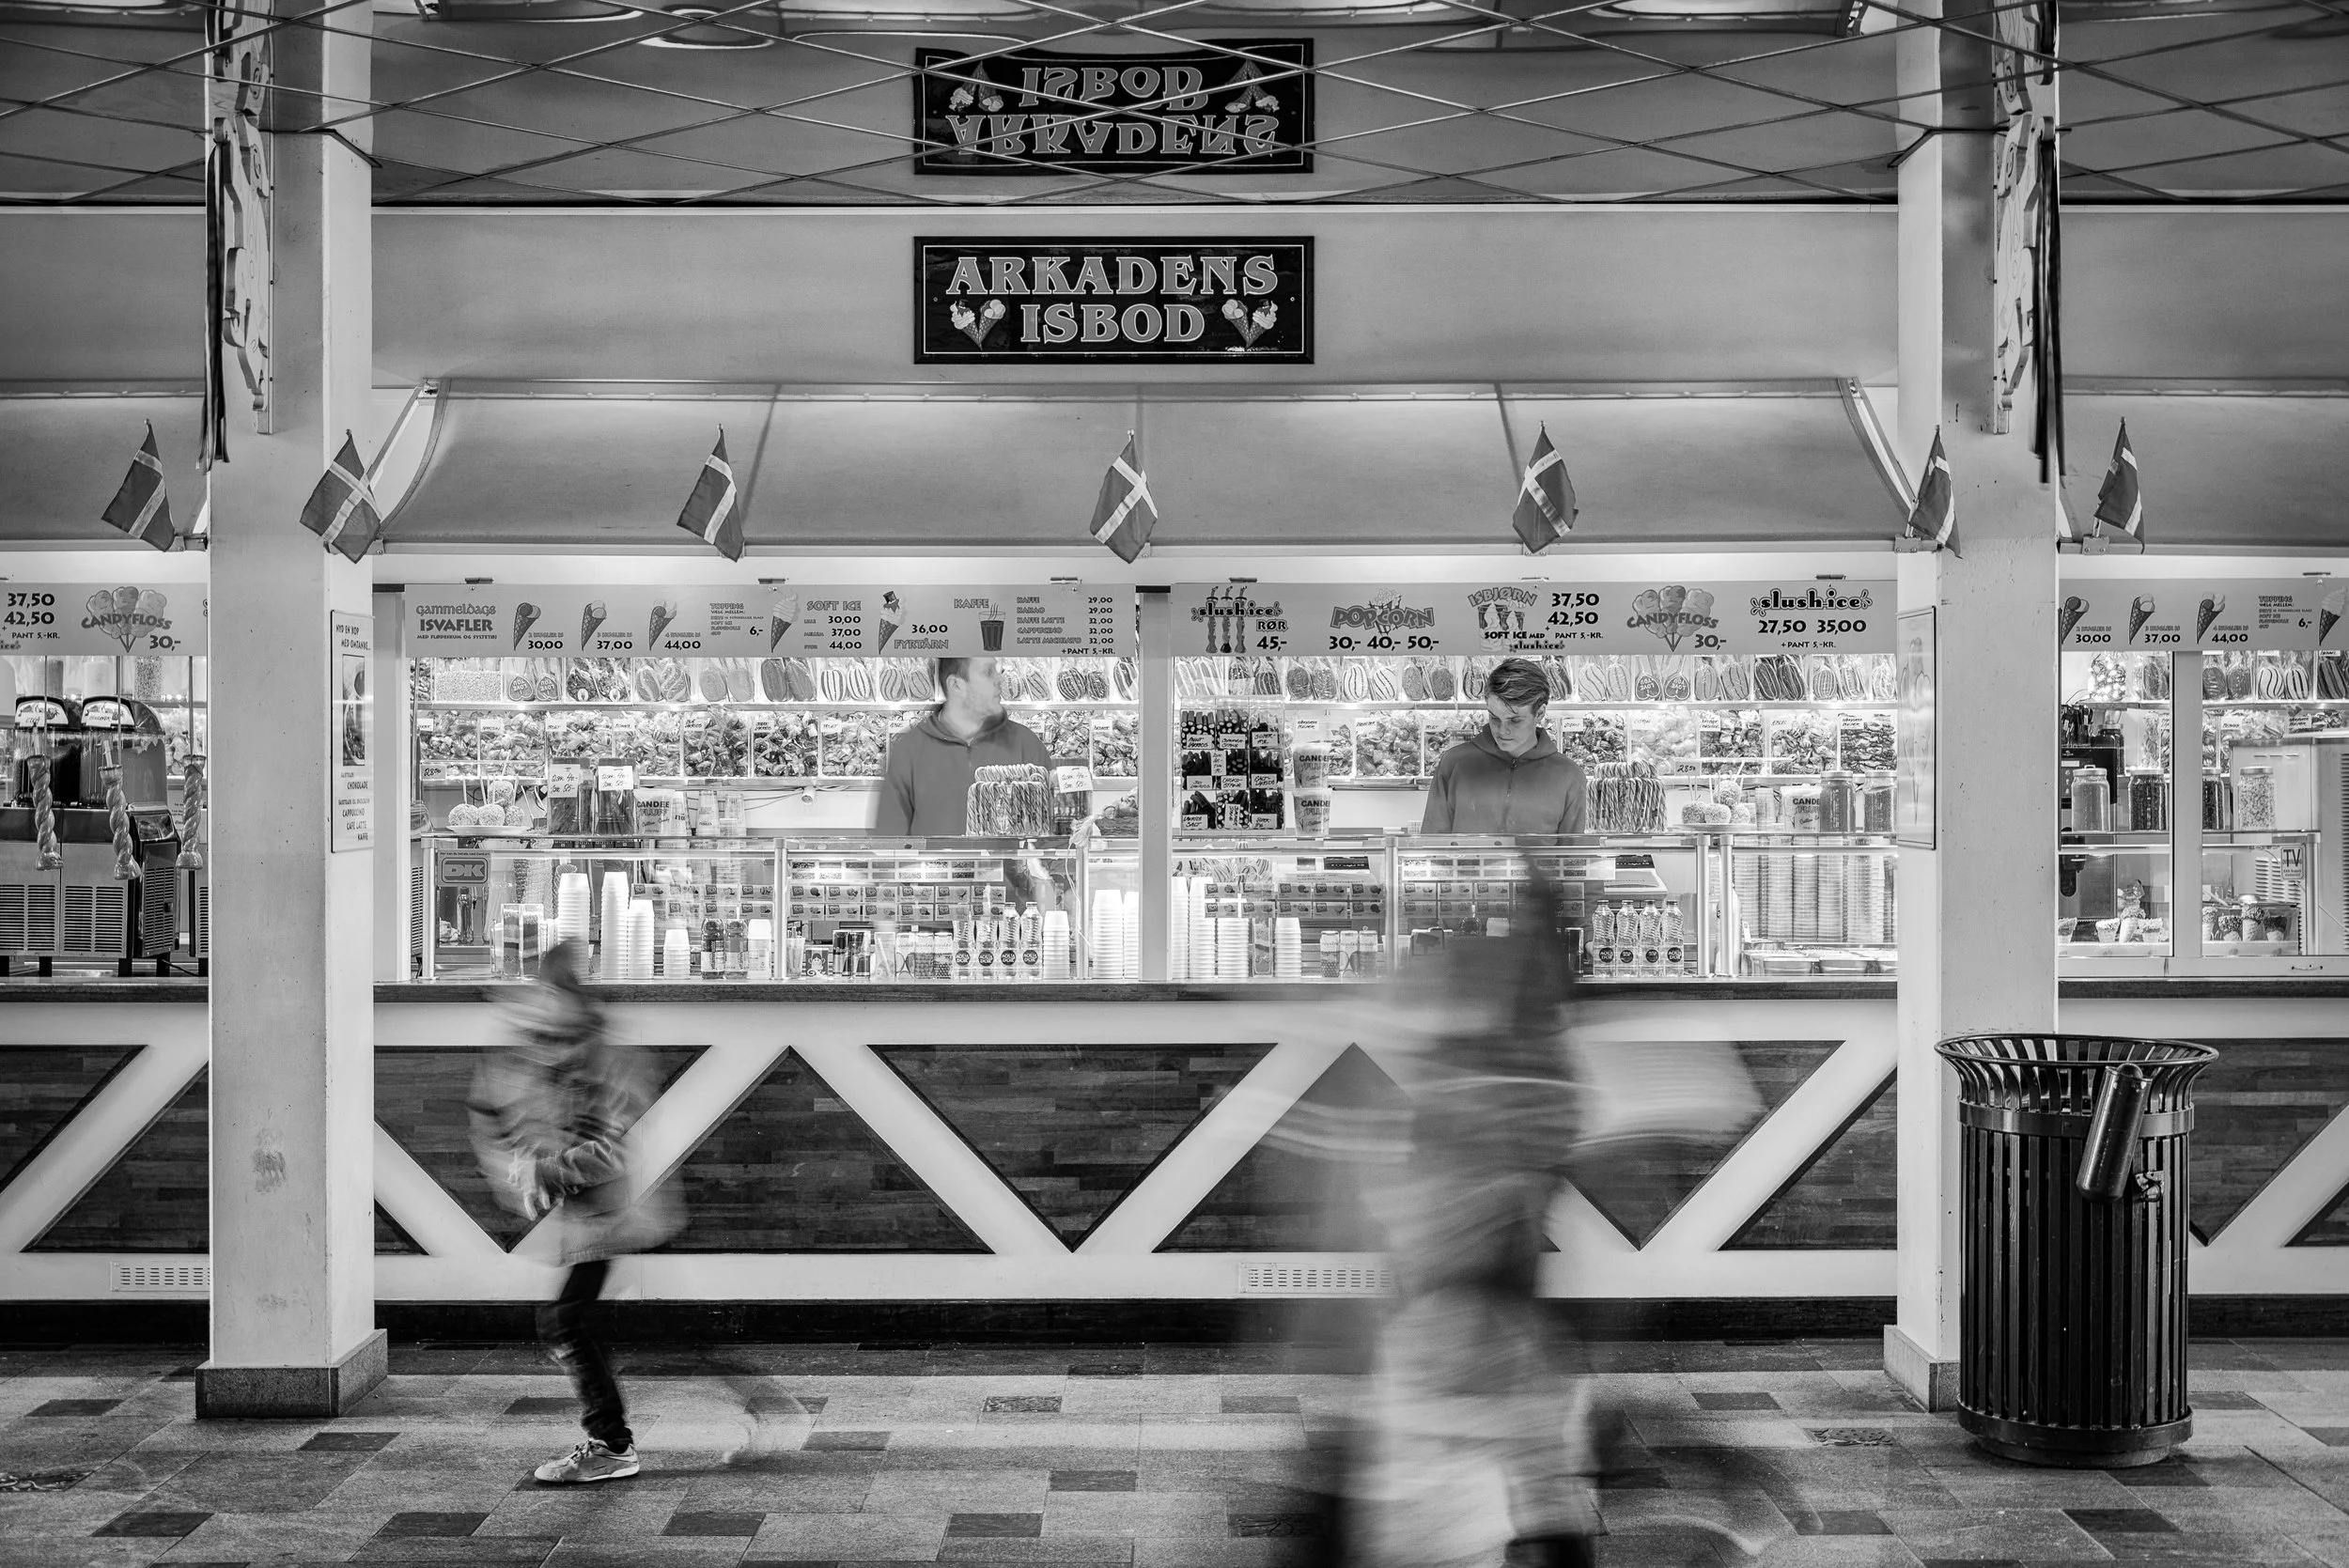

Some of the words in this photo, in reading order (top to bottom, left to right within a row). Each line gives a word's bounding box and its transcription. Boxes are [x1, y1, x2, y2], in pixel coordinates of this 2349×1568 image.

[945, 254, 1279, 296] ARKADENS
[1019, 302, 1206, 345] ISBOD
[8, 593, 55, 609] 37,50
[1088, 596, 1113, 604] 29,00
[1467, 586, 1538, 608] ISBJØRN
[1551, 593, 1600, 609] 37,50
[806, 600, 840, 611] SOFT
[843, 600, 862, 611] ICE
[954, 598, 989, 609] KAFFE
[1017, 606, 1046, 614] KAKAO
[1088, 606, 1113, 614] 29,00
[4, 611, 55, 627] 42,50
[81, 613, 173, 630] CANDYFLOSS
[828, 615, 862, 625] 30,00
[1088, 616, 1113, 625] 32,00
[1330, 605, 1436, 630] POPCORN
[1548, 611, 1599, 627] 42,50
[1626, 612, 1719, 629] CANDYFLOSS
[2298, 617, 2312, 629] 6,-
[420, 618, 494, 632] ISVAFLER
[749, 626, 763, 636] 6,-
[911, 624, 948, 635] 36,00
[1088, 627, 1113, 635] 32,00
[1256, 618, 1288, 632] RØR
[1758, 619, 1807, 635] 27,50
[1817, 619, 1867, 635] 35,00
[832, 628, 862, 638] 37,00
[1484, 630, 1510, 640] SOFT
[1513, 630, 1528, 640] ICE
[2076, 633, 2111, 644] 30,00
[2144, 633, 2181, 644] 37,00
[2211, 633, 2248, 644] 44,00
[149, 634, 181, 651] 30,-
[528, 640, 564, 651] 30,00
[597, 640, 633, 651] 37,00
[664, 640, 701, 651] 44,00
[829, 641, 863, 651] 44,00
[894, 637, 949, 649] FYRTÅRN
[1089, 637, 1114, 645] 32,00
[1256, 635, 1287, 651] 45,-
[1329, 635, 1361, 651] 30,-
[1367, 635, 1401, 651] 40,-
[1408, 635, 1439, 651] 50,-
[1694, 633, 1727, 650] 30,-
[2283, 848, 2301, 867] TV
[444, 864, 484, 877] DK
